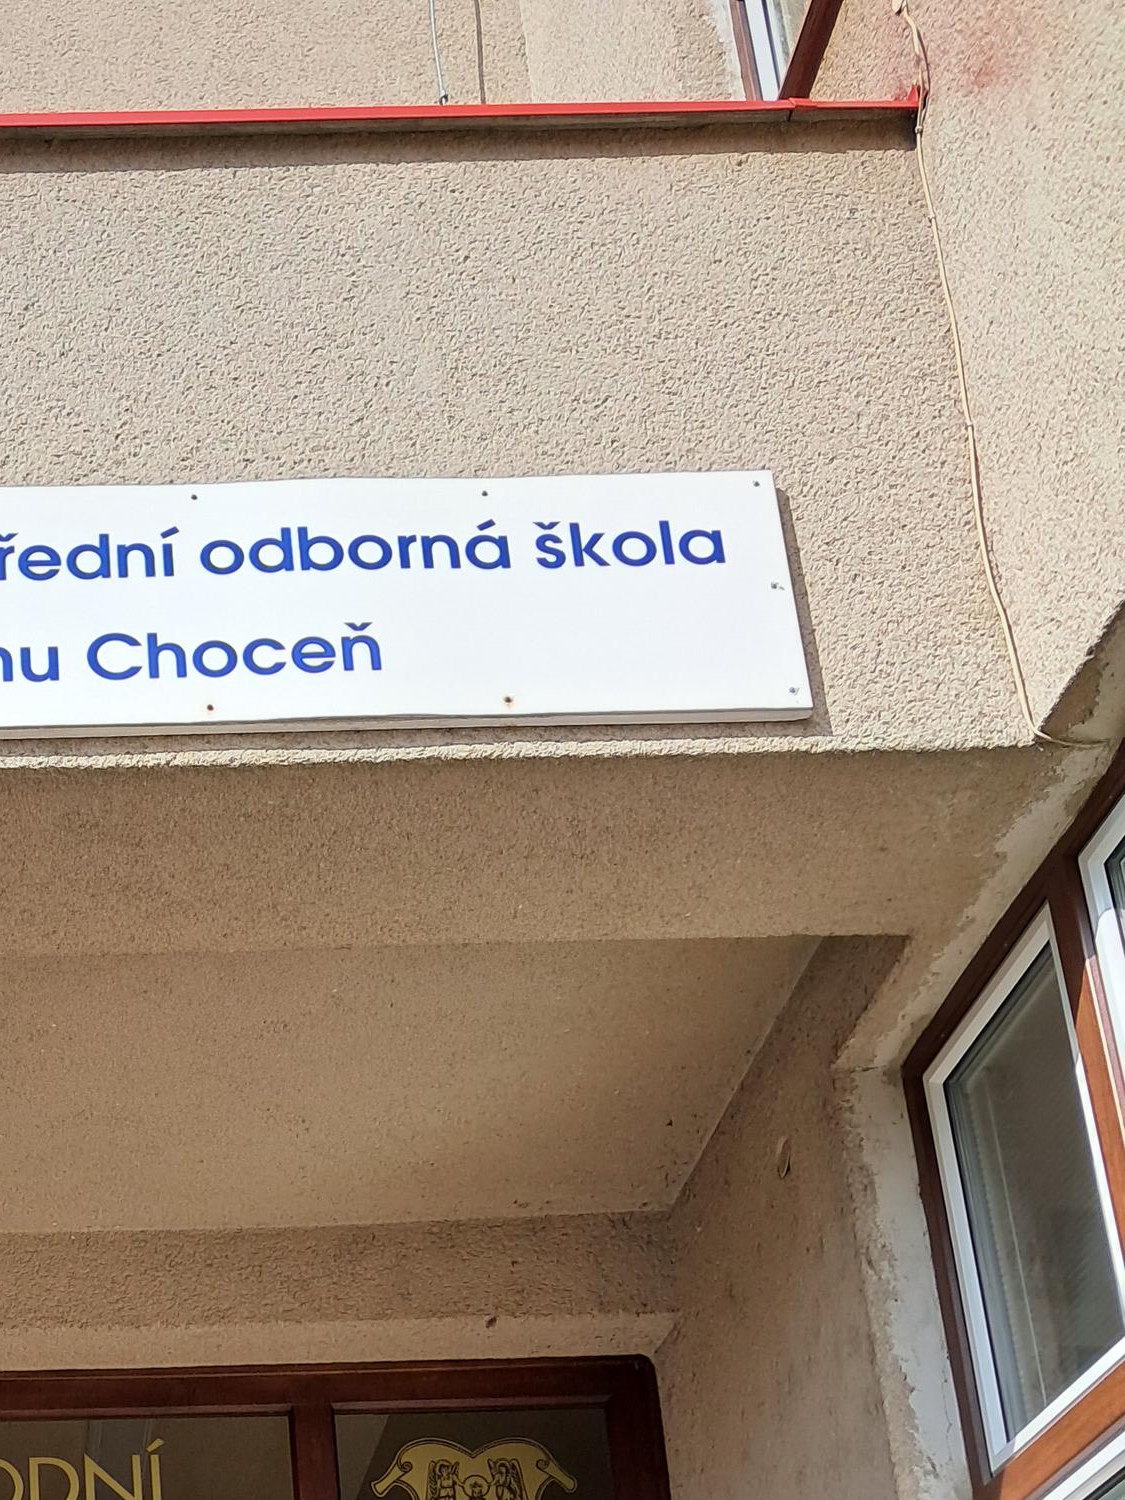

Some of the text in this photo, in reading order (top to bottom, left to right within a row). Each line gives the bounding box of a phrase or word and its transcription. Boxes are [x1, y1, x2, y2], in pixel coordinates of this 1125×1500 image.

[199, 518, 511, 575] odborná
[535, 519, 726, 570] škola
[86, 623, 383, 681] Choceň
